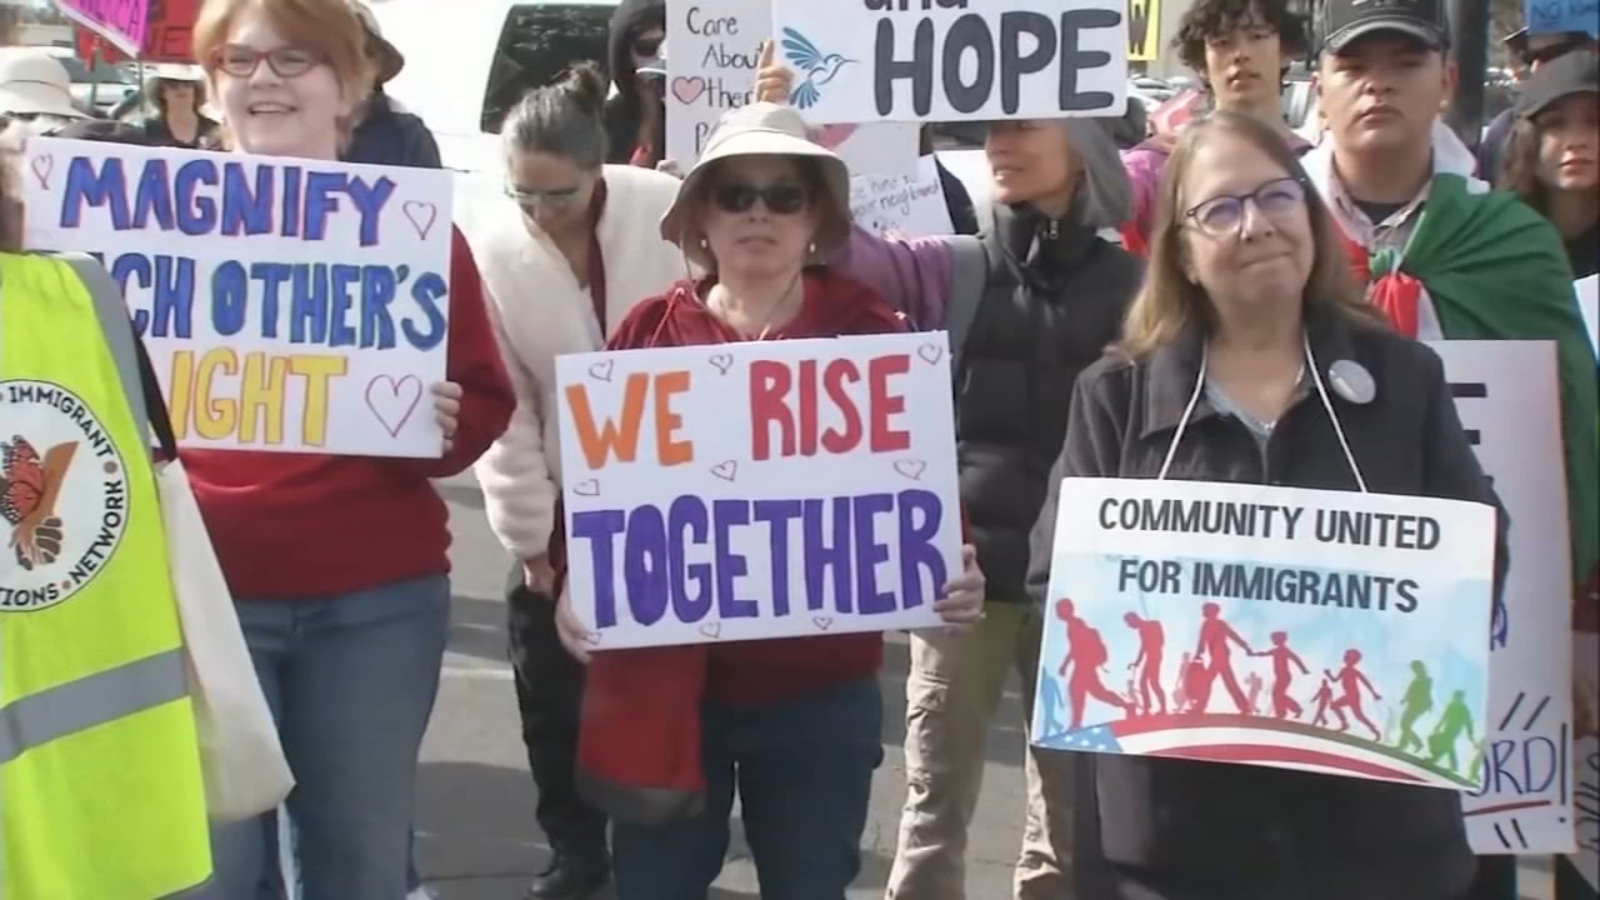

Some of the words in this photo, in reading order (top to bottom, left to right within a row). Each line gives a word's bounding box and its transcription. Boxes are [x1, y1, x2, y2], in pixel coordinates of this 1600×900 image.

[686, 6, 739, 36] Care
[874, 9, 1122, 117] HOPE
[60, 156, 398, 247] MAGNIFY
[111, 252, 196, 339] CH
[210, 260, 448, 352] OTHER'S
[9, 386, 115, 457] IMMIGRANT
[169, 346, 348, 448] IGHT
[565, 371, 694, 470] WE
[749, 354, 911, 461] RISE
[68, 479, 124, 585] NETWORK
[572, 489, 949, 629] TOGETHER
[1099, 498, 1304, 541] COMMUNITY
[1314, 509, 1441, 552] UNITED
[1118, 559, 1181, 595] FOR
[1191, 562, 1420, 613] IMMIGRANTS
